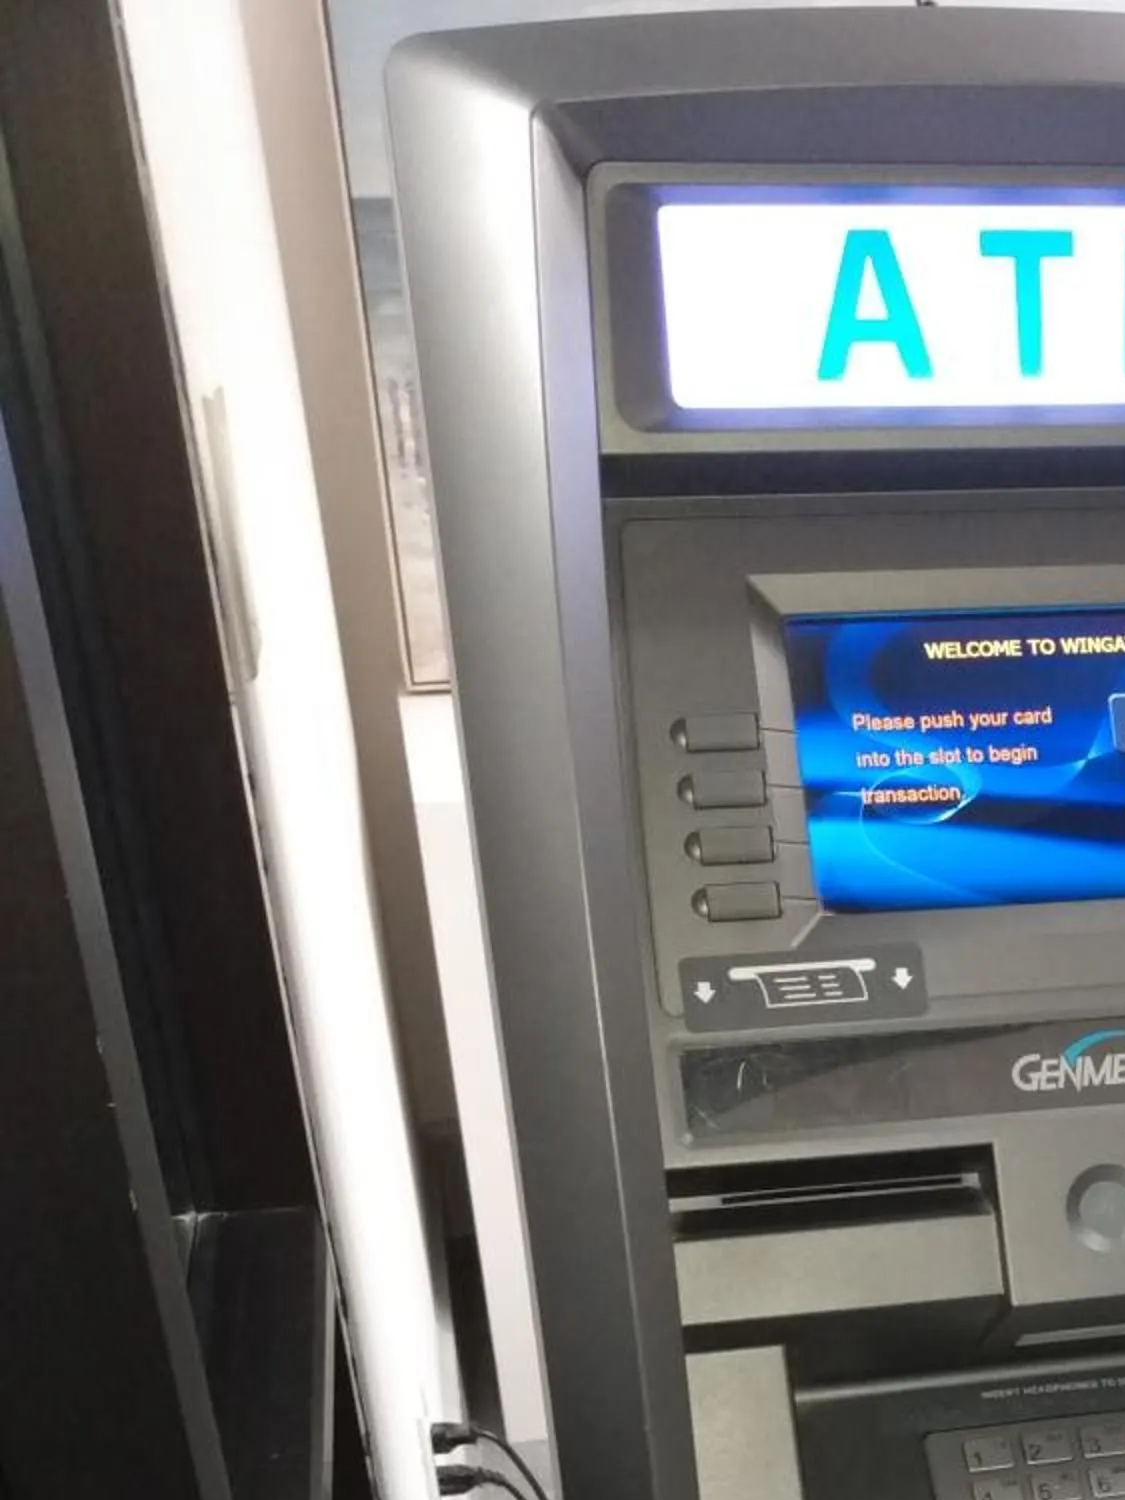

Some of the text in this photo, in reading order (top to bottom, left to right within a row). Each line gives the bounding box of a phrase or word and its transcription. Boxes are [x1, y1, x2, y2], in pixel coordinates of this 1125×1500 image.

[924, 639, 1022, 660] WELCOME
[1026, 638, 1055, 656] TO
[852, 706, 1052, 731] Please push your card
[856, 744, 1038, 768] into the slot to begin
[861, 784, 966, 804] transaction.
[972, 1451, 982, 1465] 1
[1028, 1443, 1041, 1460] 2
[1038, 1483, 1051, 1500] 5
[1099, 1476, 1111, 1493] 6
